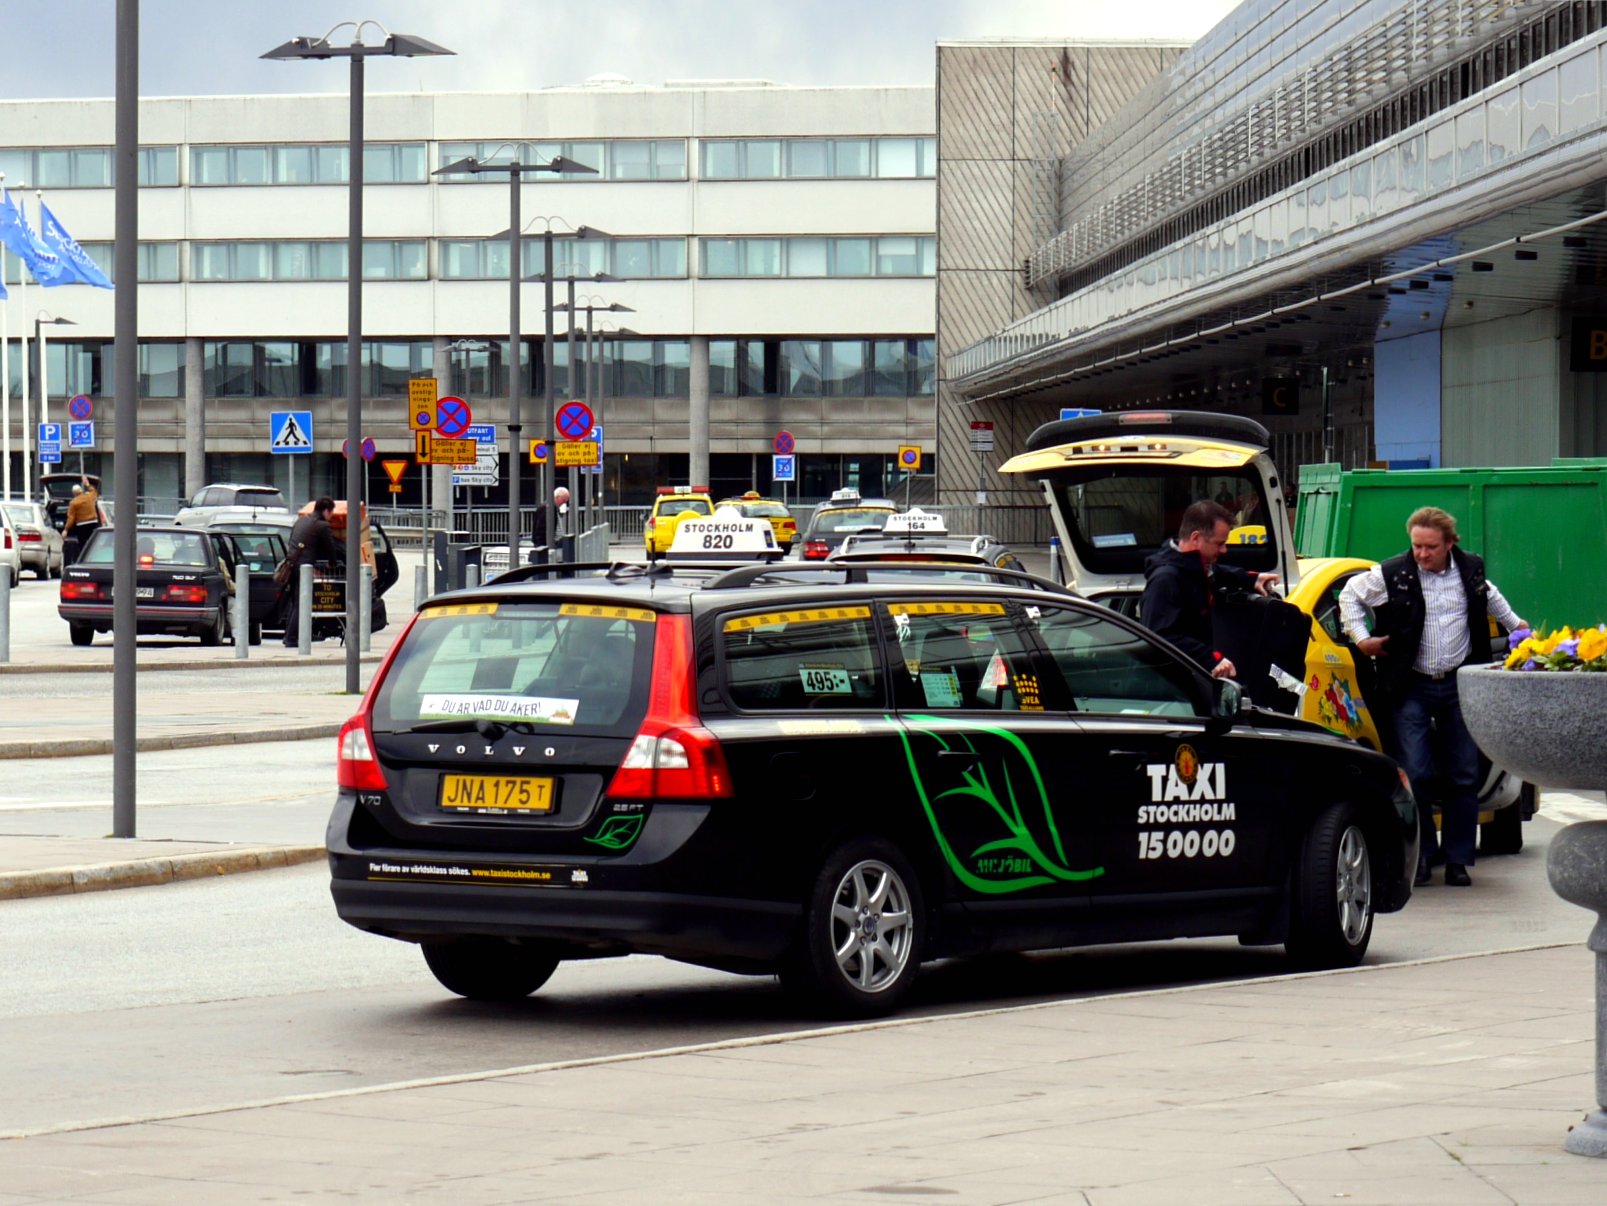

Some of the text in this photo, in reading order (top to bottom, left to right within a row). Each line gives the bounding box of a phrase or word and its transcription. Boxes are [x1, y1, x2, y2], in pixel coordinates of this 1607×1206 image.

[1590, 330, 1607, 360] B
[1273, 387, 1287, 407] C
[44, 425, 57, 441] P
[684, 523, 754, 533] STOCKHOLM
[907, 522, 925, 530] 164
[702, 534, 734, 549] 820
[441, 699, 457, 713] DU
[472, 699, 493, 713] VAD
[494, 699, 509, 713] DU
[427, 744, 556, 757] VOLVO
[1146, 763, 1226, 802] TAXI
[1137, 802, 1236, 824] STOCKHOLM
[401, 866, 410, 874] av
[411, 864, 448, 875] världsklass
[471, 867, 552, 880] www.taxistockholm.se
